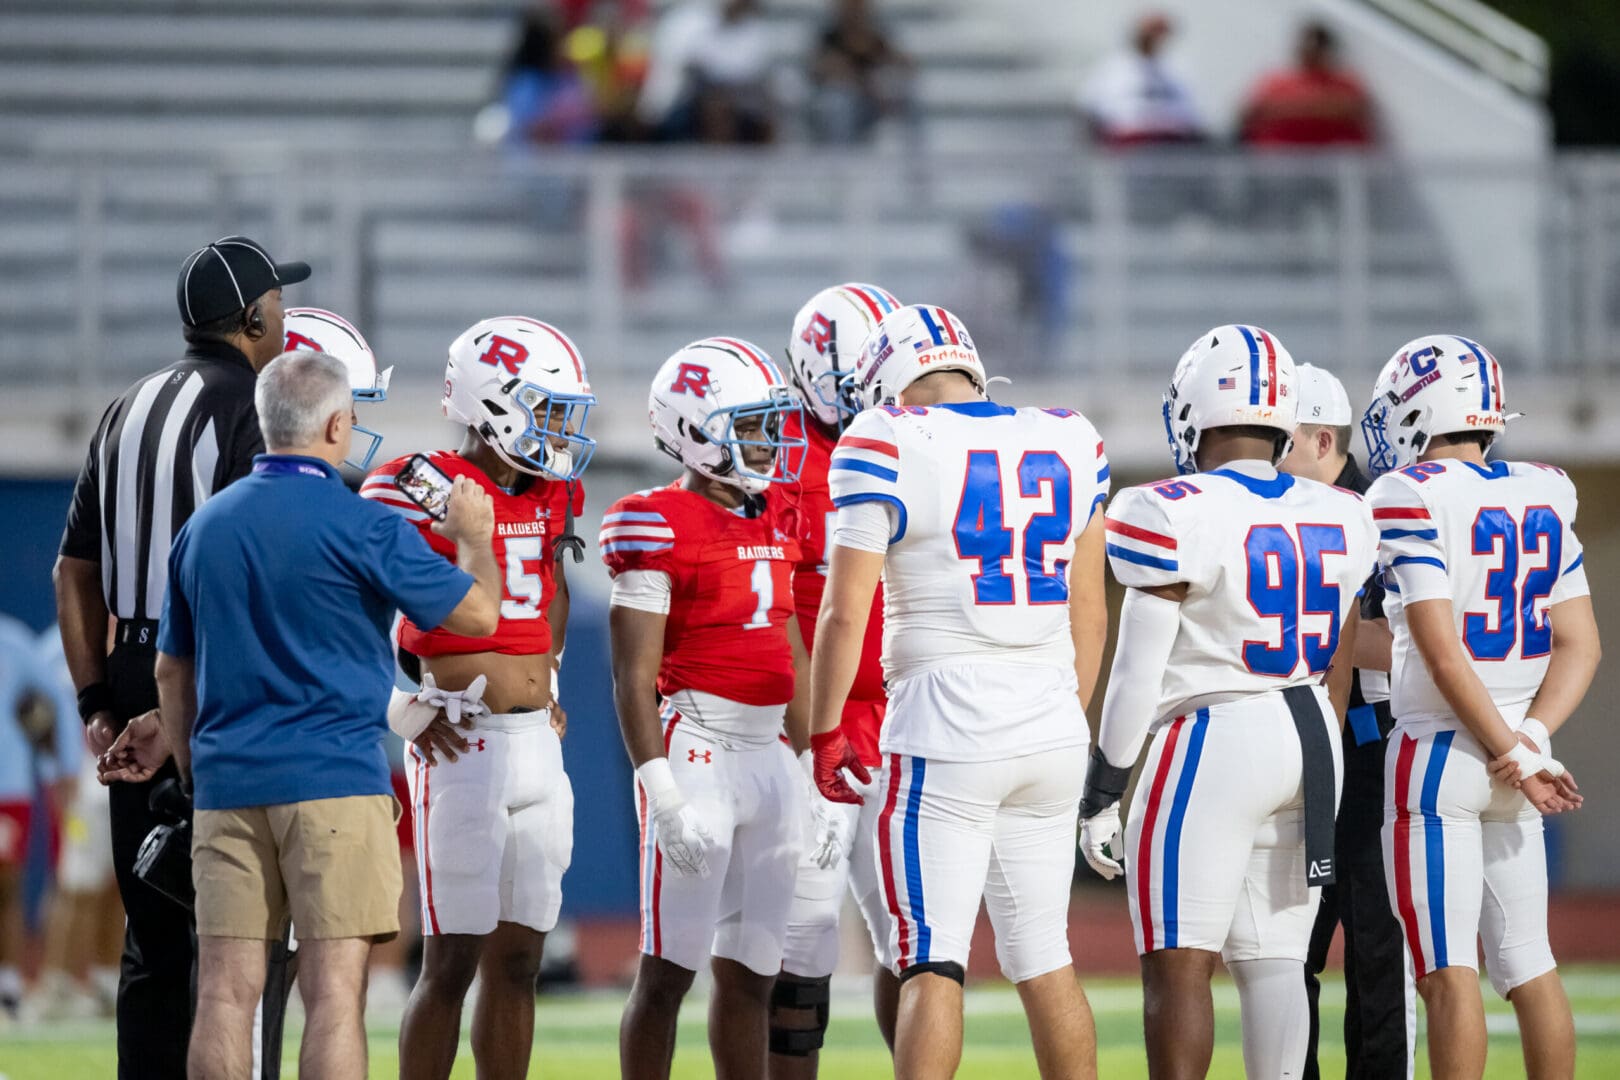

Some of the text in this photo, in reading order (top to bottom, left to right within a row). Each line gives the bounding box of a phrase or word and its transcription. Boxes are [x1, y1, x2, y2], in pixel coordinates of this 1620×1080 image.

[479, 335, 530, 376] R
[1410, 347, 1437, 377] C
[670, 362, 710, 399] R
[1312, 406, 1321, 416] S
[498, 521, 546, 536] RAIDERS
[952, 449, 1072, 606] 42
[738, 546, 785, 560] RAIDERS
[500, 536, 543, 620] 5
[743, 559, 774, 630] 1
[1462, 505, 1563, 662] 32
[1241, 523, 1347, 678] 95
[139, 627, 149, 644] S
